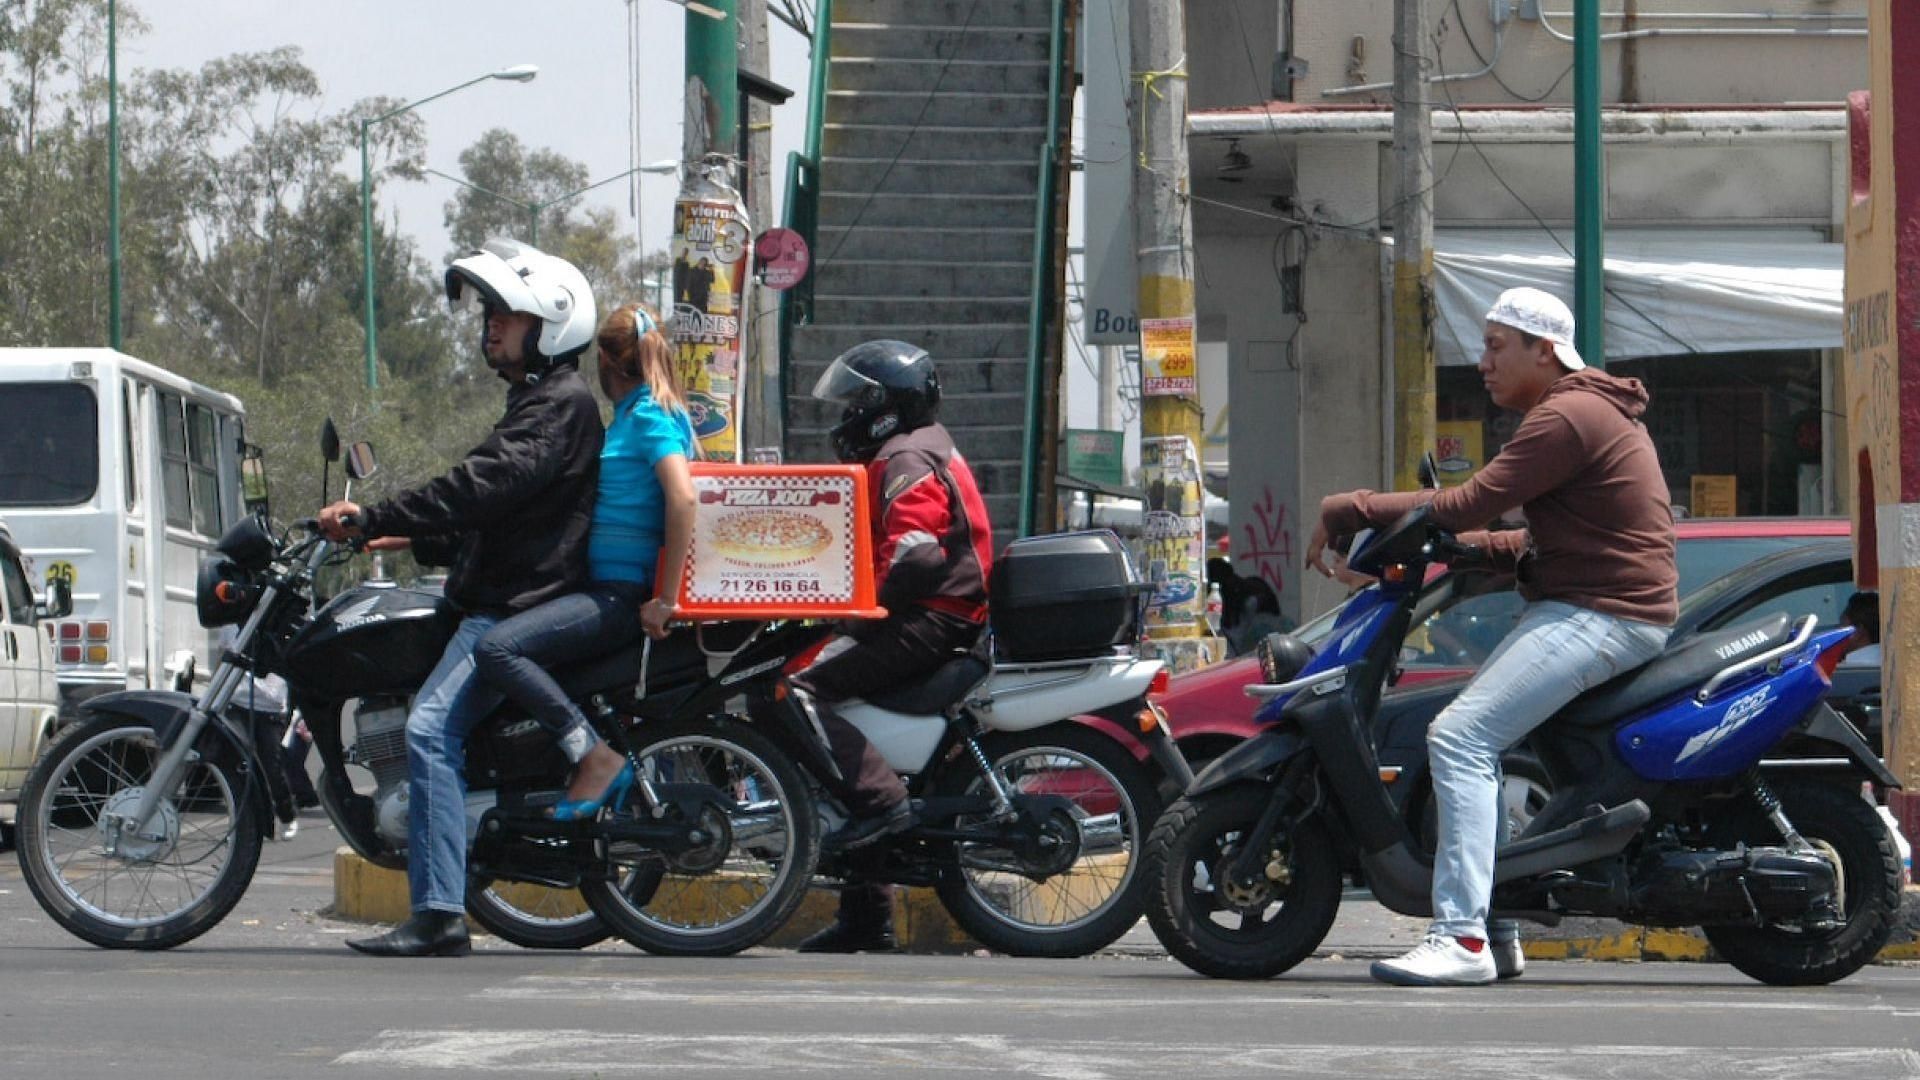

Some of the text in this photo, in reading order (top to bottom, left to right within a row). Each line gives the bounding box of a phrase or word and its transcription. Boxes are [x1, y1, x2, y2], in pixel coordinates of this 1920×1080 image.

[714, 220, 747, 264] 3
[724, 489, 769, 505] PIZZA
[720, 580, 820, 592] 21 26 16 64
[1715, 630, 1770, 660] YAMAHA
